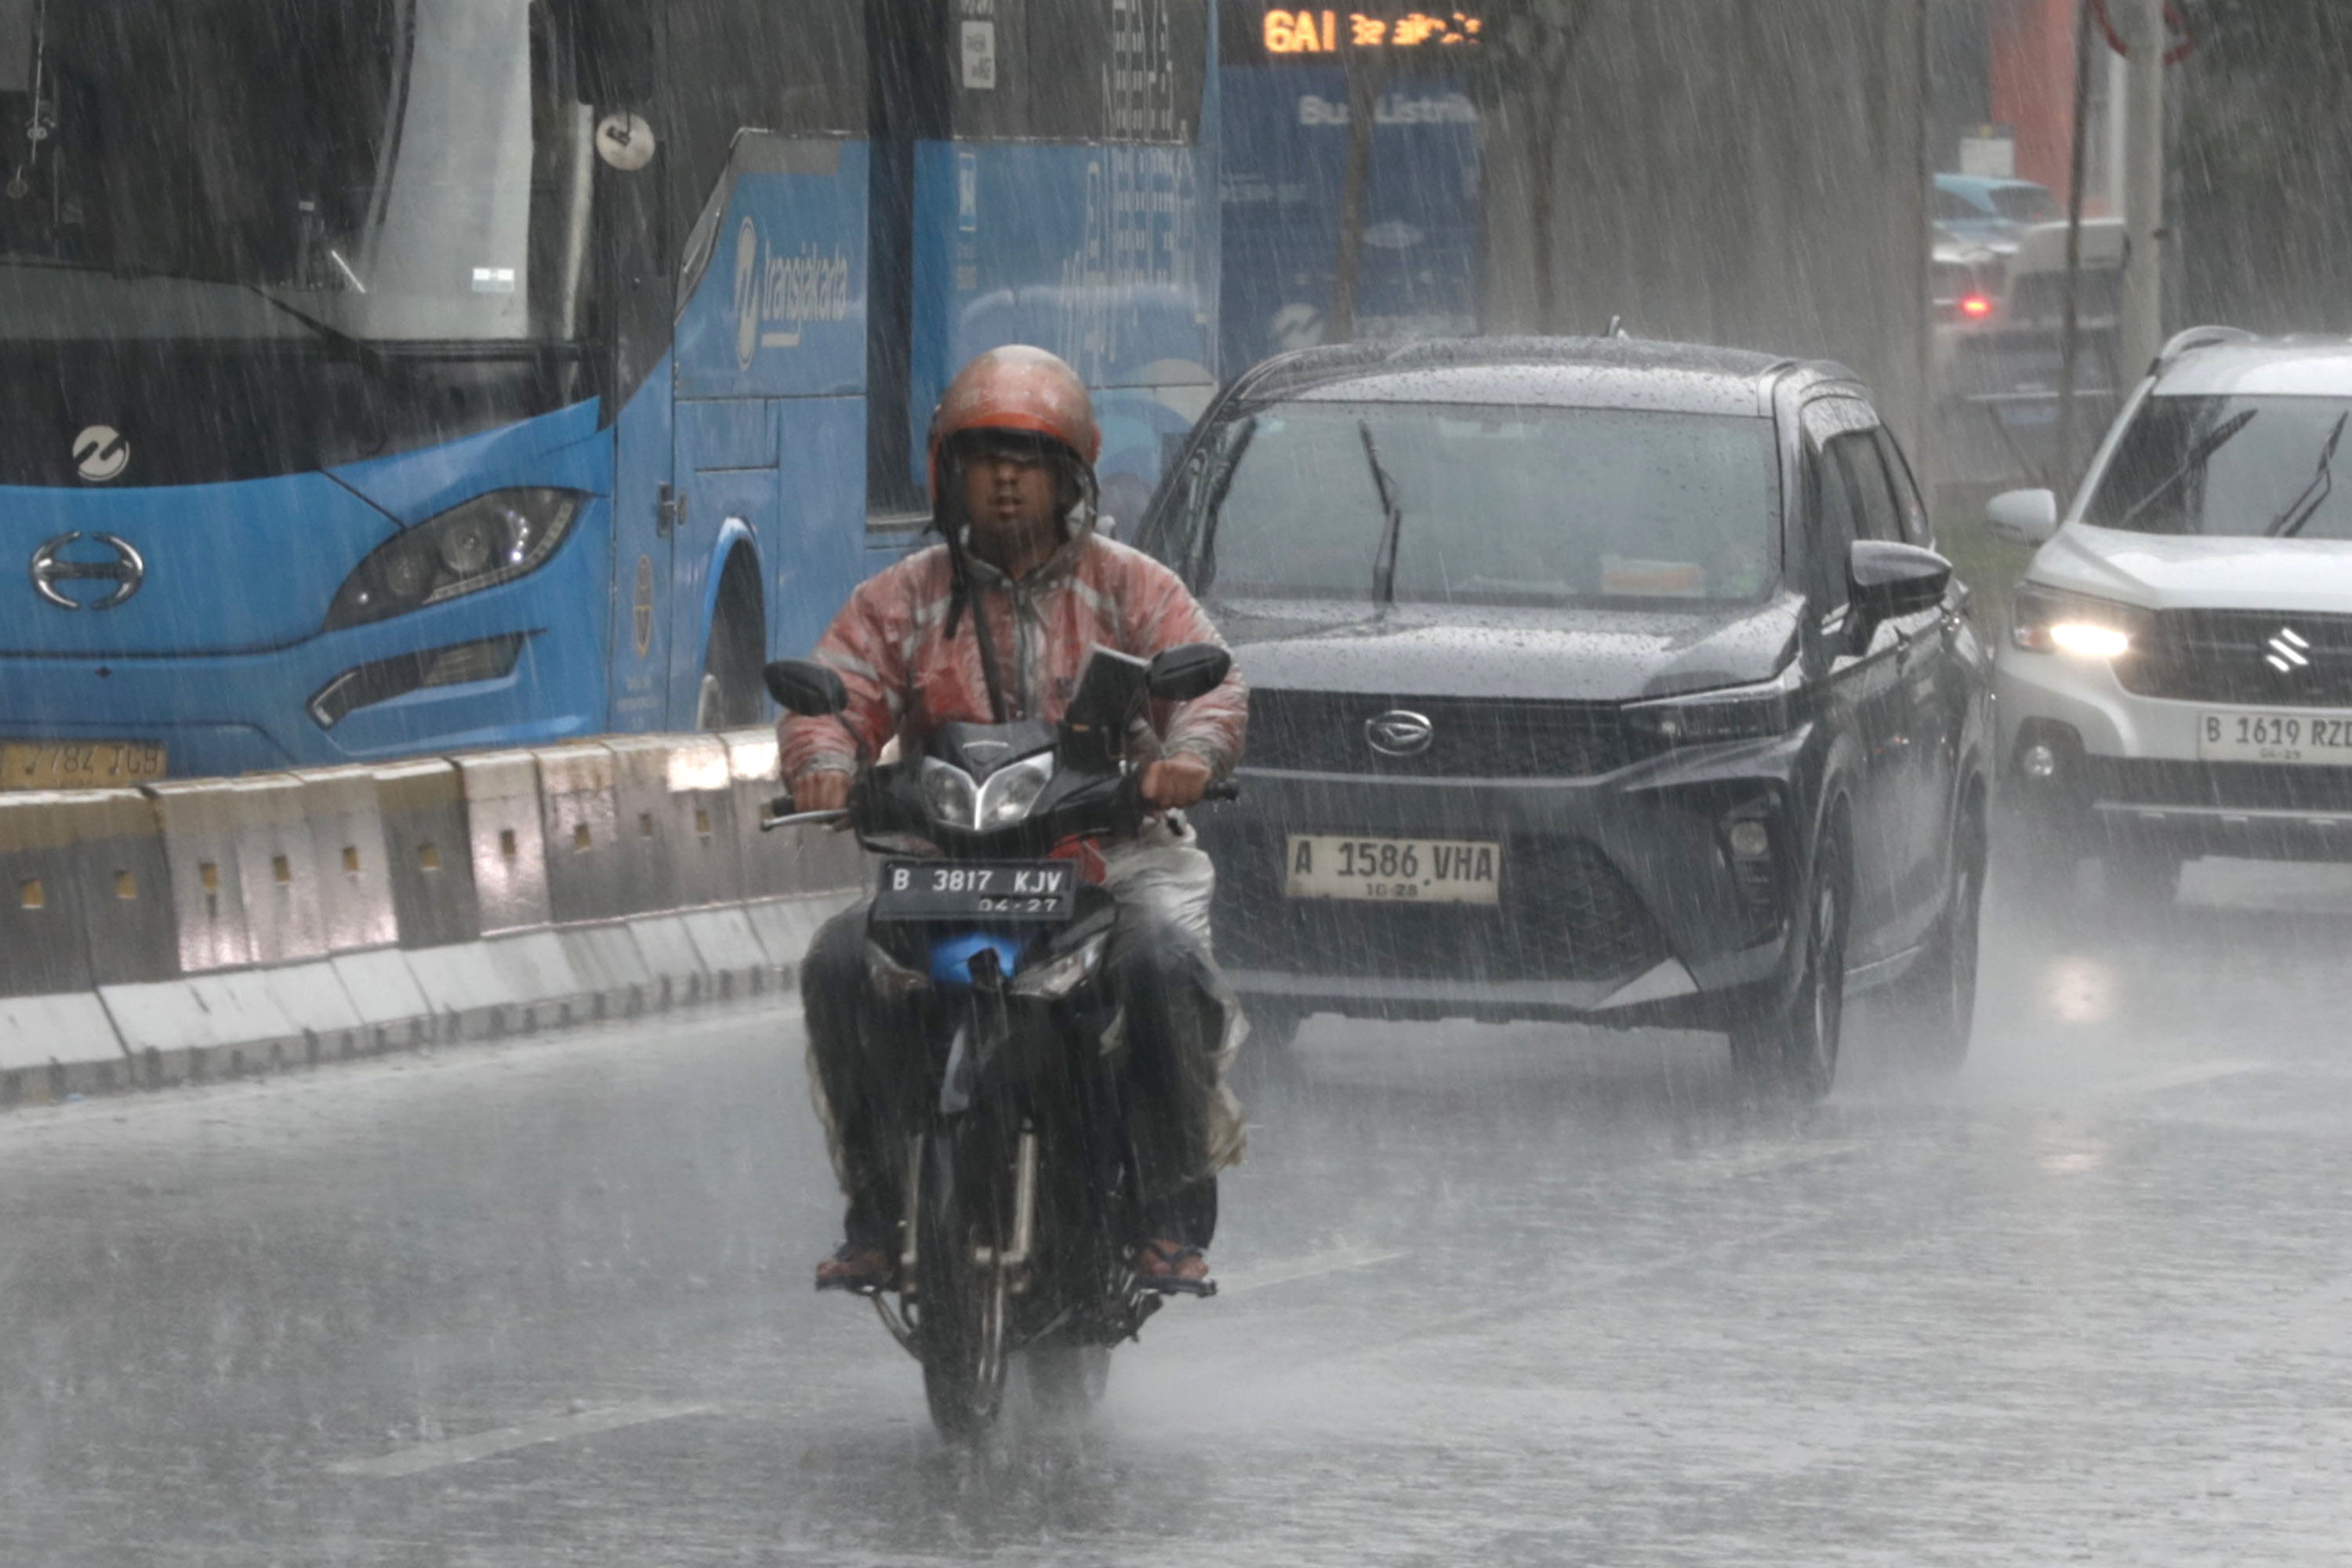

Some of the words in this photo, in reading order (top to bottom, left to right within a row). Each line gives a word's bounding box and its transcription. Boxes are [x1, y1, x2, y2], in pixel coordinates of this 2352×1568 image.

[2206, 716, 2221, 742] B
[2235, 717, 2300, 745] 1619
[1294, 840, 1313, 875] A
[1337, 841, 1418, 878] 1586
[1432, 845, 1493, 881] VHA
[892, 868, 911, 891] B
[931, 869, 994, 891] 3817
